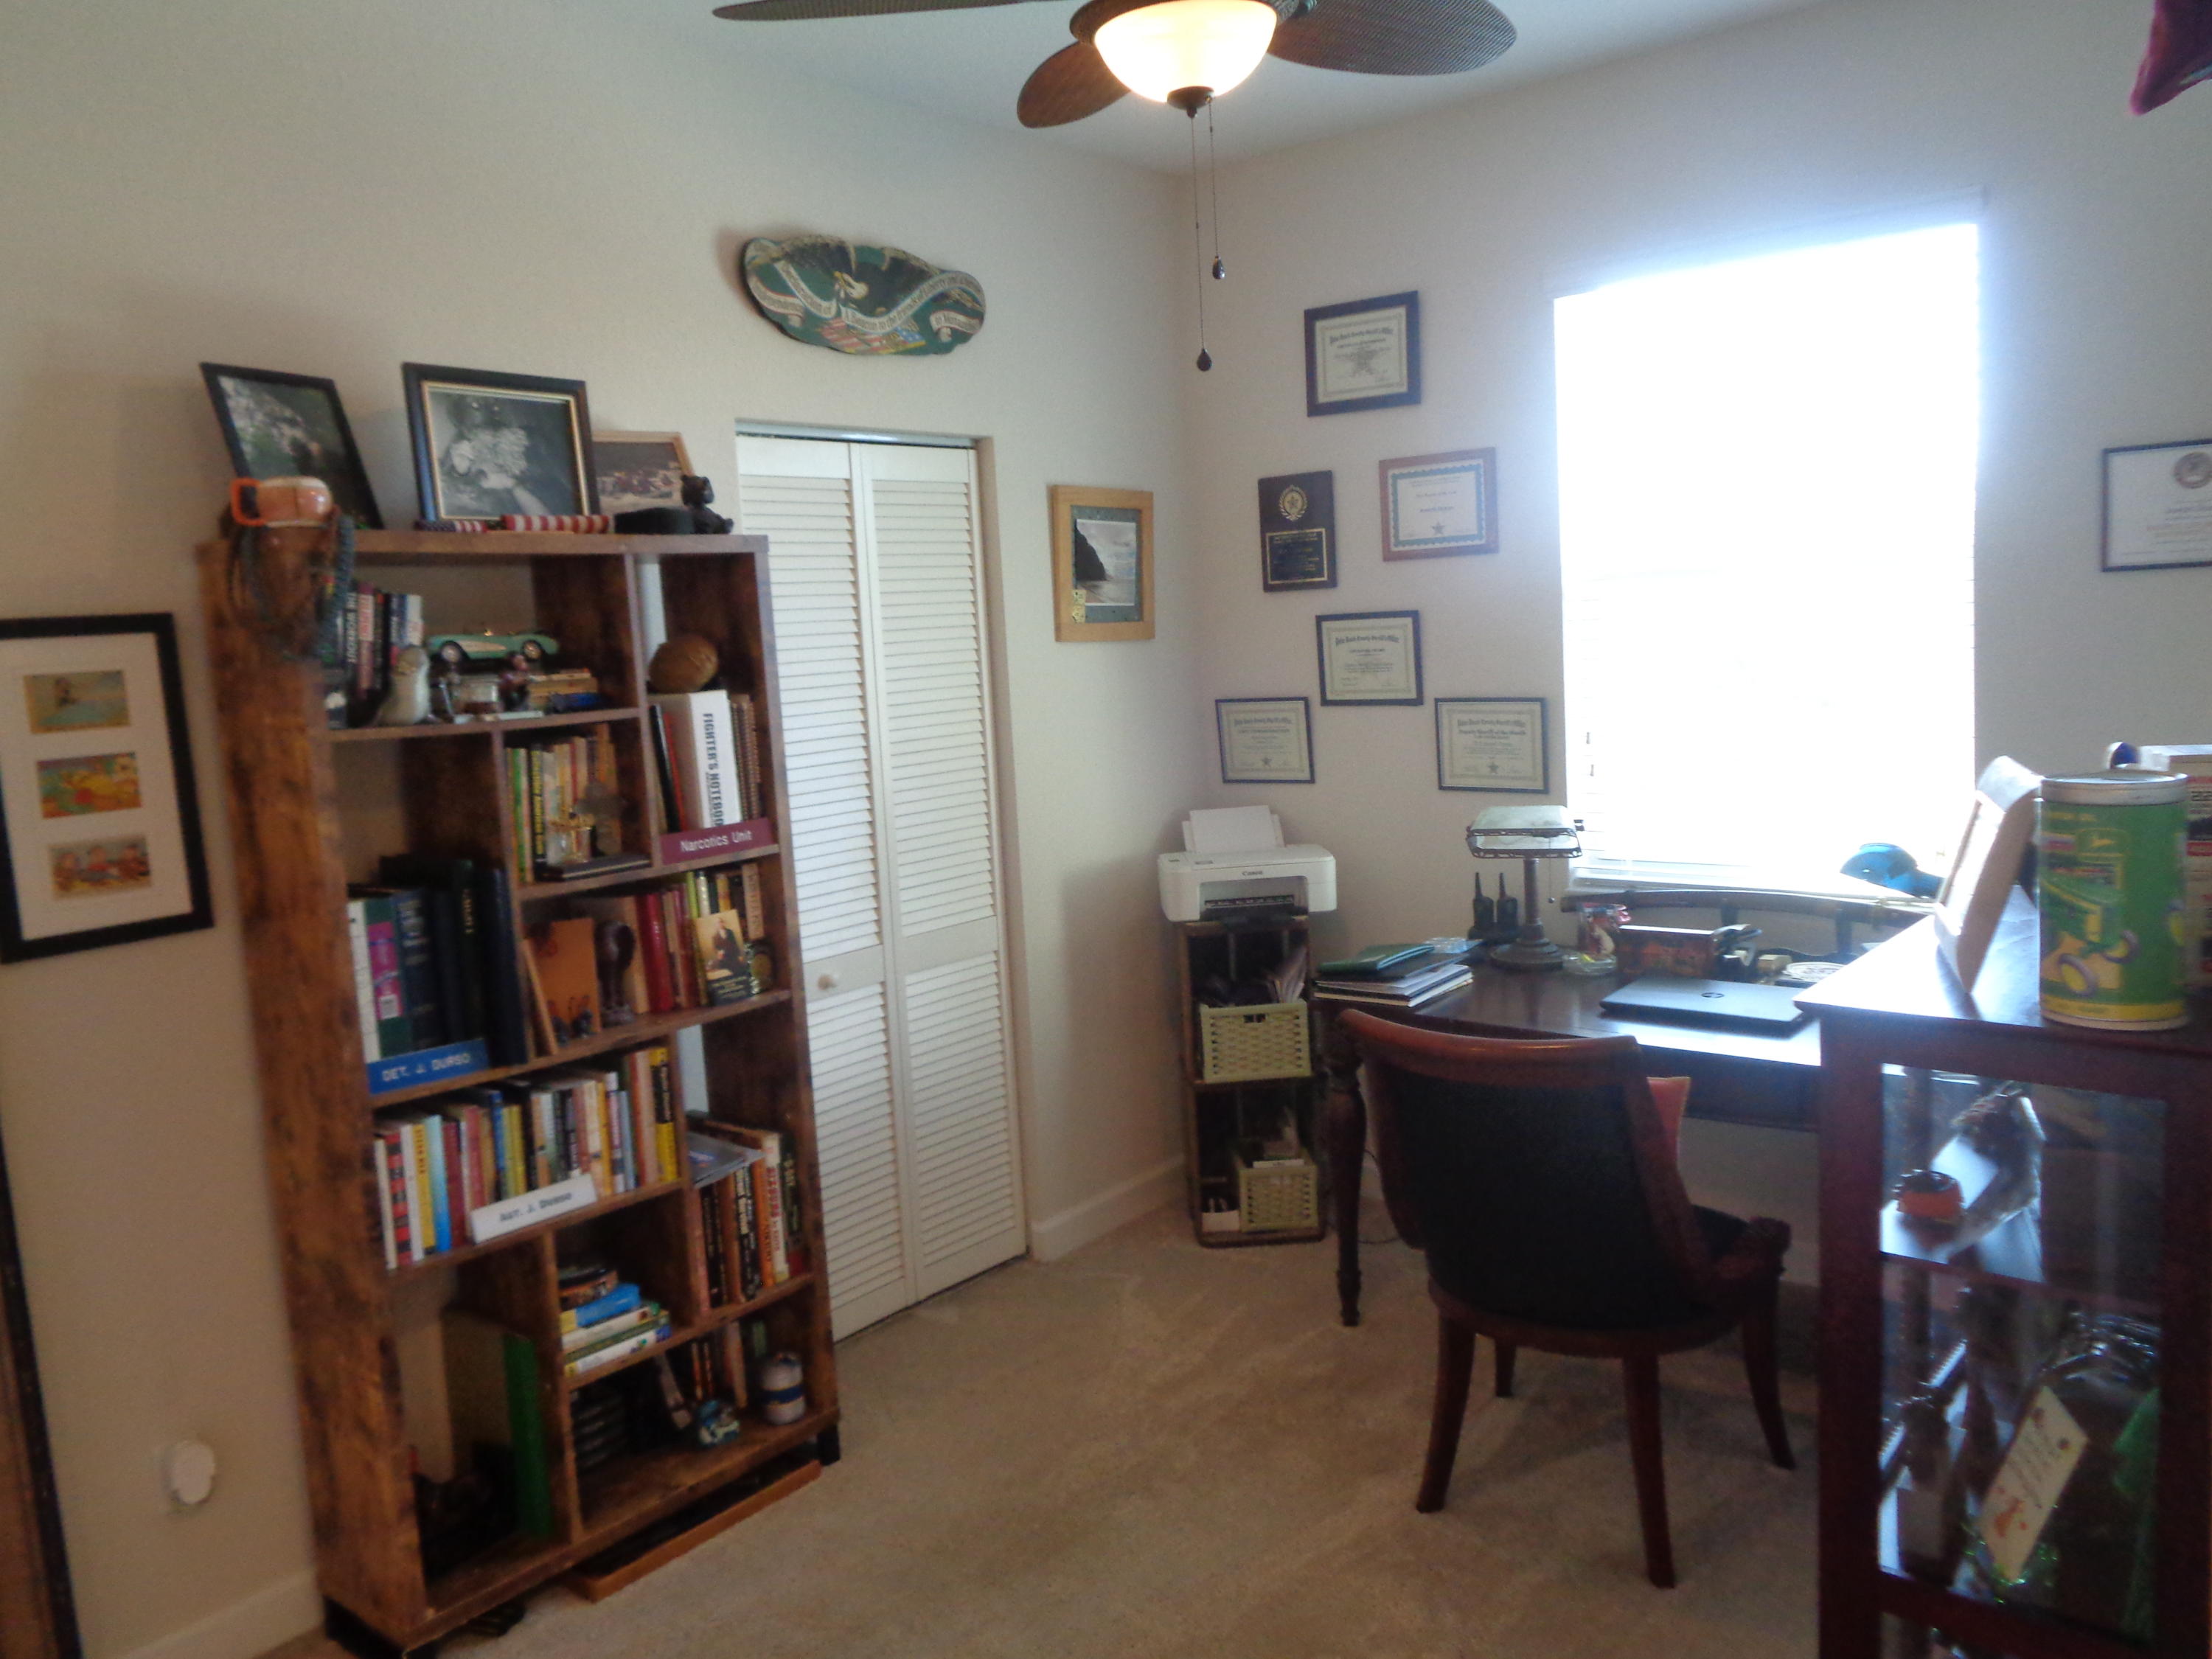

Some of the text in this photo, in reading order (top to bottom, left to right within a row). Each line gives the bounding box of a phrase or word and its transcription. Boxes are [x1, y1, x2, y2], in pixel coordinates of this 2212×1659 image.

[703, 713, 720, 771] FIGHTER'S
[709, 772, 725, 826] NOTEBOO
[680, 830, 752, 852] Narcotics Unit
